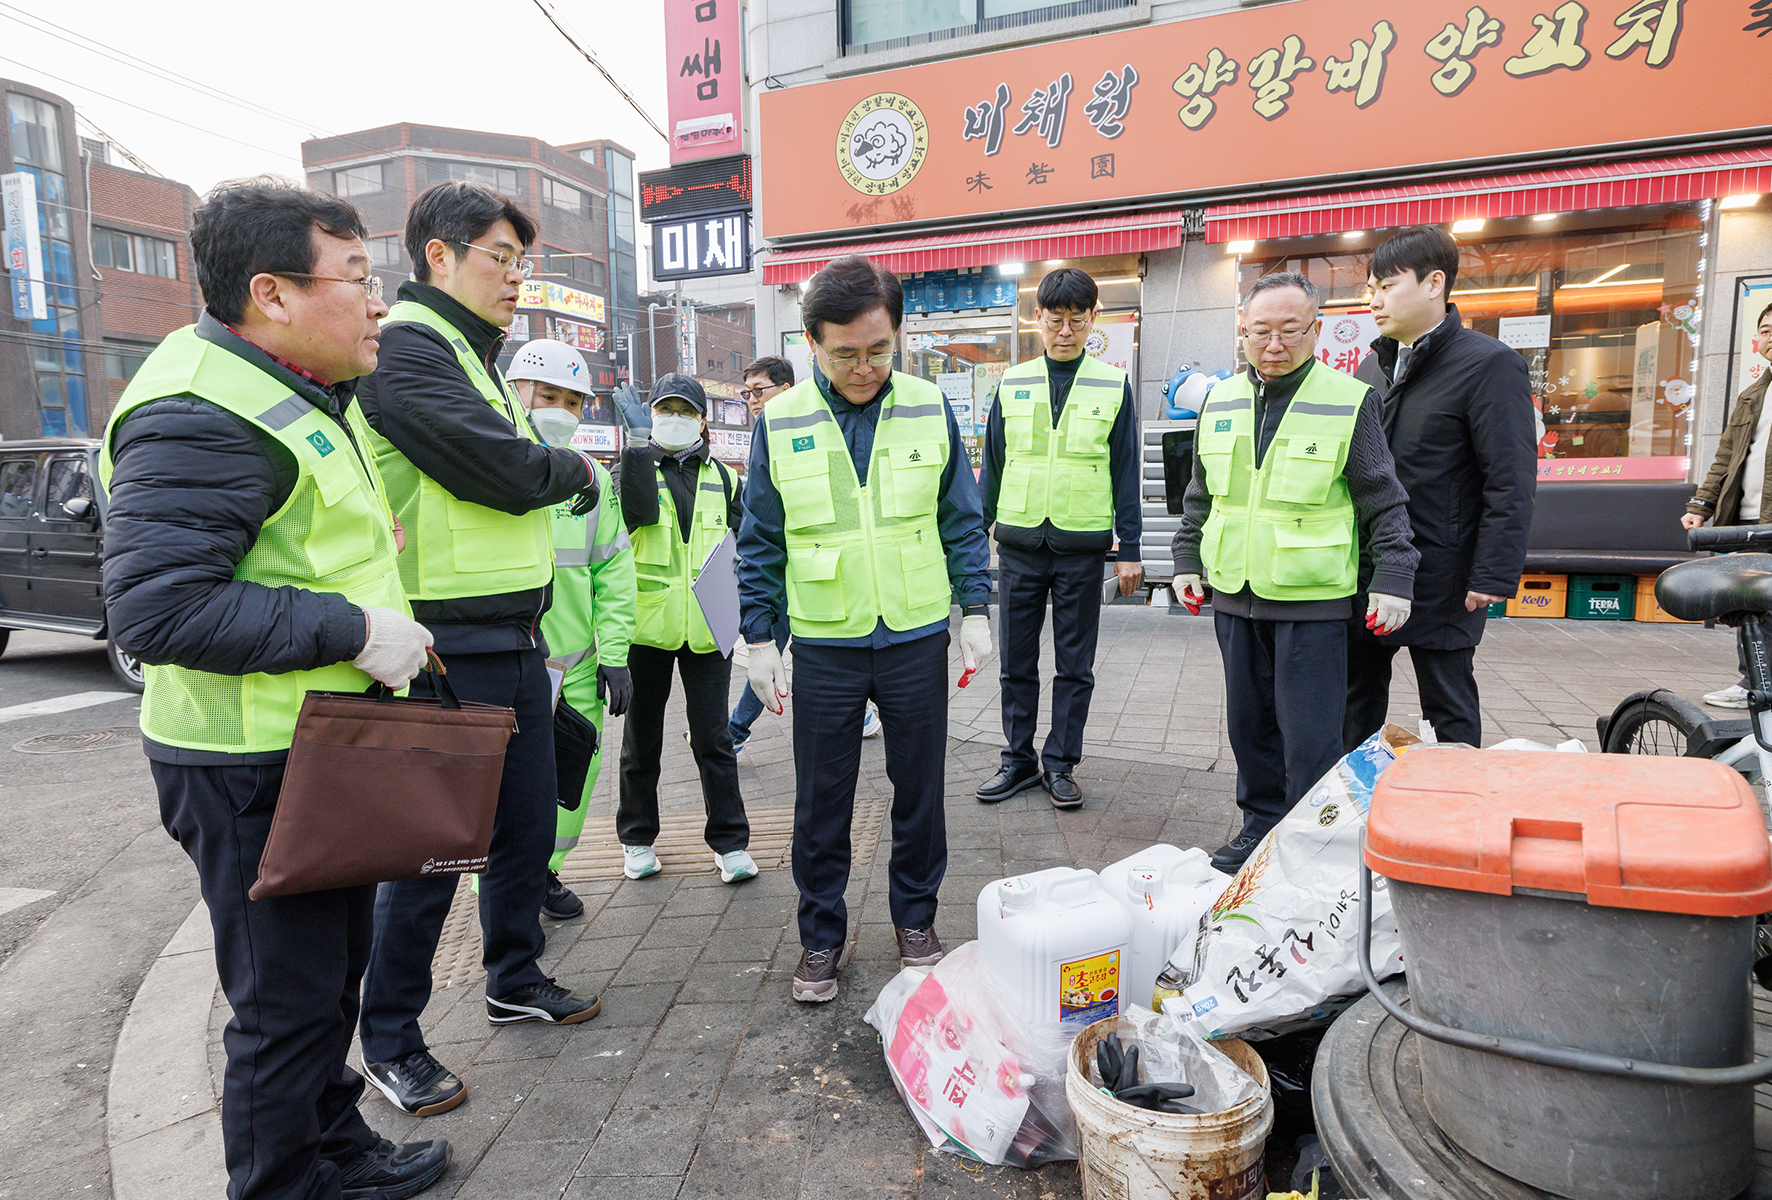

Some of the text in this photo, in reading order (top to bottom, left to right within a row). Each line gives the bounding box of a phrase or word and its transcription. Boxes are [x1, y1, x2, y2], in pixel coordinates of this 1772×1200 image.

[1173, 0, 1687, 130] 양갈비 양꼬치
[963, 63, 1140, 157] 미채원
[661, 216, 743, 272] 미채
[525, 283, 542, 292] 3F
[598, 370, 615, 386] BAR
[594, 435, 607, 445] HOF
[727, 433, 750, 446] 전문점
[1521, 595, 1552, 608] Kelly
[1588, 597, 1620, 610] TERRA
[1226, 928, 1315, 1003] 신동진
[1194, 999, 1215, 1012] 20kg
